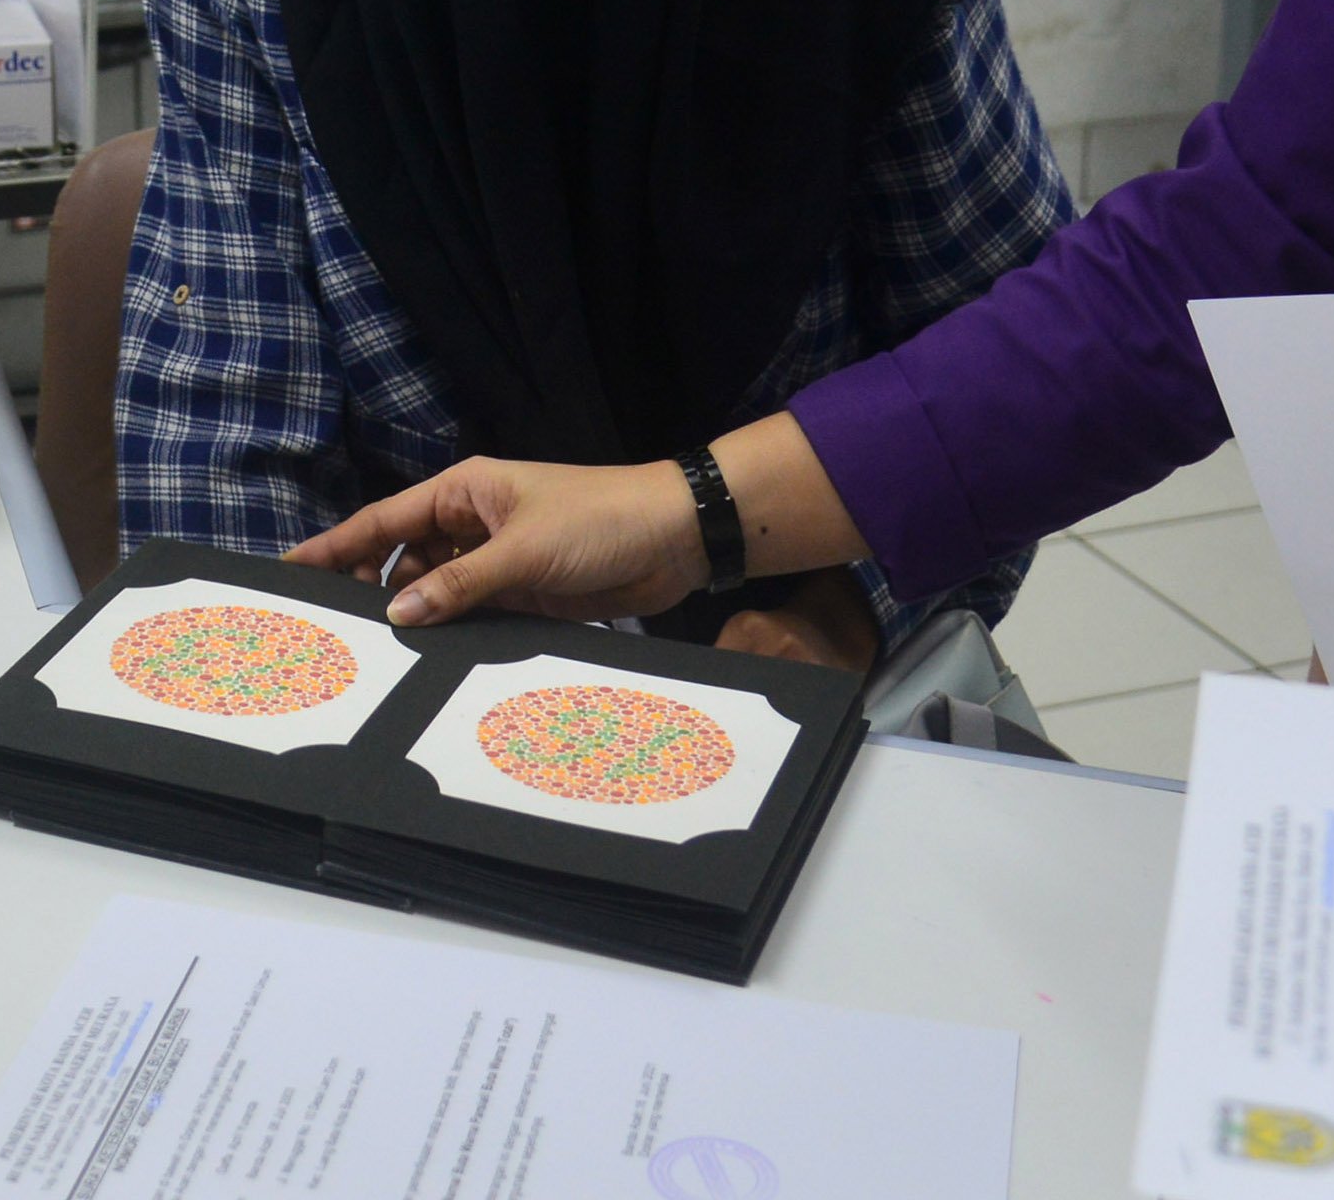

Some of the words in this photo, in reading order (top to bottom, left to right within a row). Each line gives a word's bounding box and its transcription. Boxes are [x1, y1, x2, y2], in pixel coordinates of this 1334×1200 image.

[35, 1066, 61, 1092] KOTA
[51, 1033, 79, 1064] BANDA
[69, 1006, 95, 1033] ACEH
[487, 1044, 508, 1070] Warna
[3, 1142, 38, 1183] RUMAH
[26, 1111, 56, 1142] SAKIT
[44, 1079, 74, 1111] UMUM
[62, 1040, 96, 1079] DAERAH
[85, 994, 122, 1039] MEURAXA
[480, 1071, 498, 1091] Buta
[75, 1165, 104, 1199] SURAT
[93, 1097, 141, 1164] KETERANGAN
[130, 1068, 156, 1095] TIDAK
[146, 1041, 170, 1067] BUTA
[160, 1006, 189, 1040] WARNA
[458, 1125, 479, 1152] Warna
[450, 1152, 469, 1174] Buta
